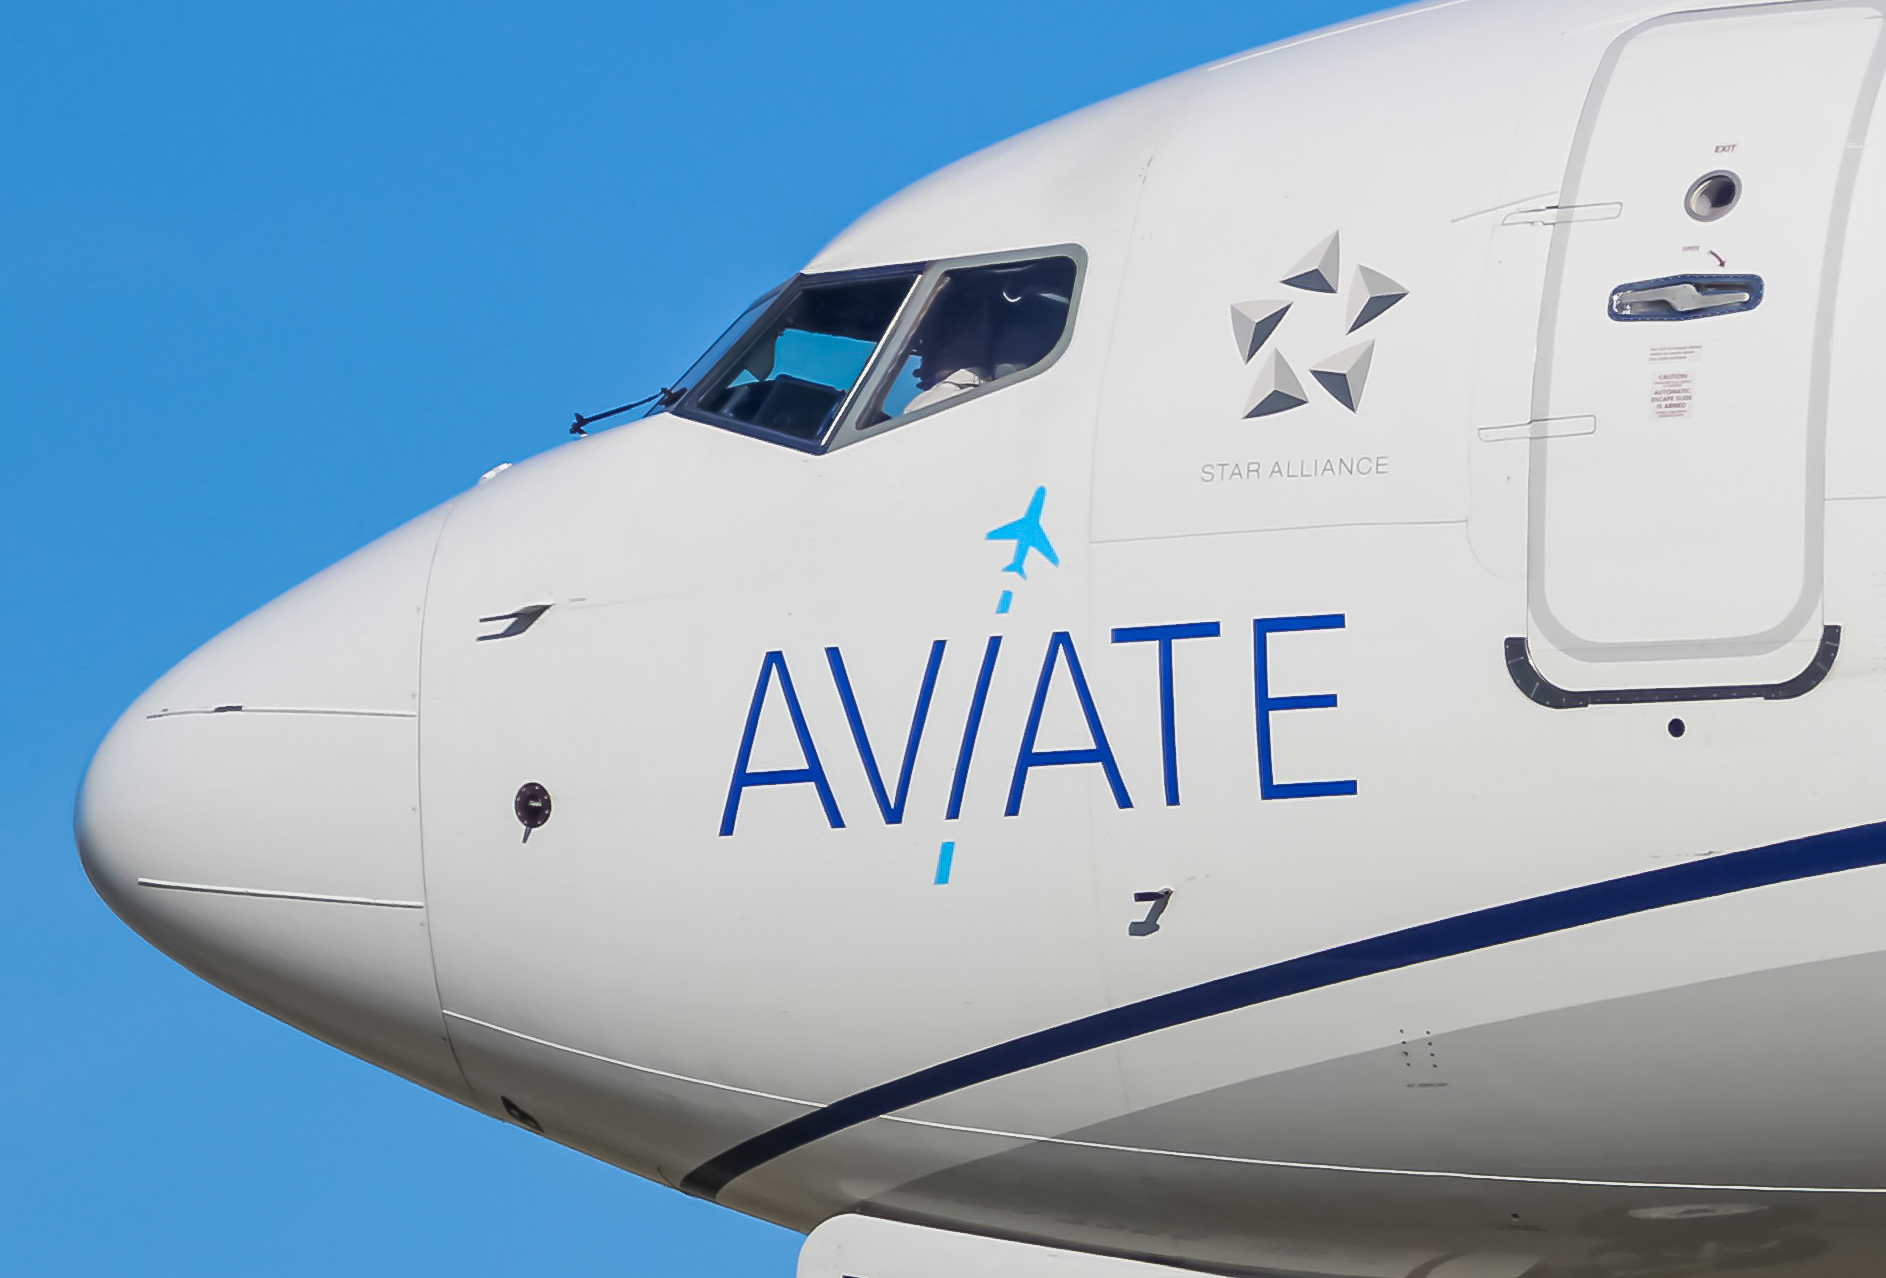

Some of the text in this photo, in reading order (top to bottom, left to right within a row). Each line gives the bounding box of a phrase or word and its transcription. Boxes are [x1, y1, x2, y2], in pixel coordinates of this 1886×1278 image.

[1714, 144, 1737, 153] EXIT
[1200, 456, 1390, 483] STAR ALLIANCE
[718, 614, 1358, 836] AVIATE
